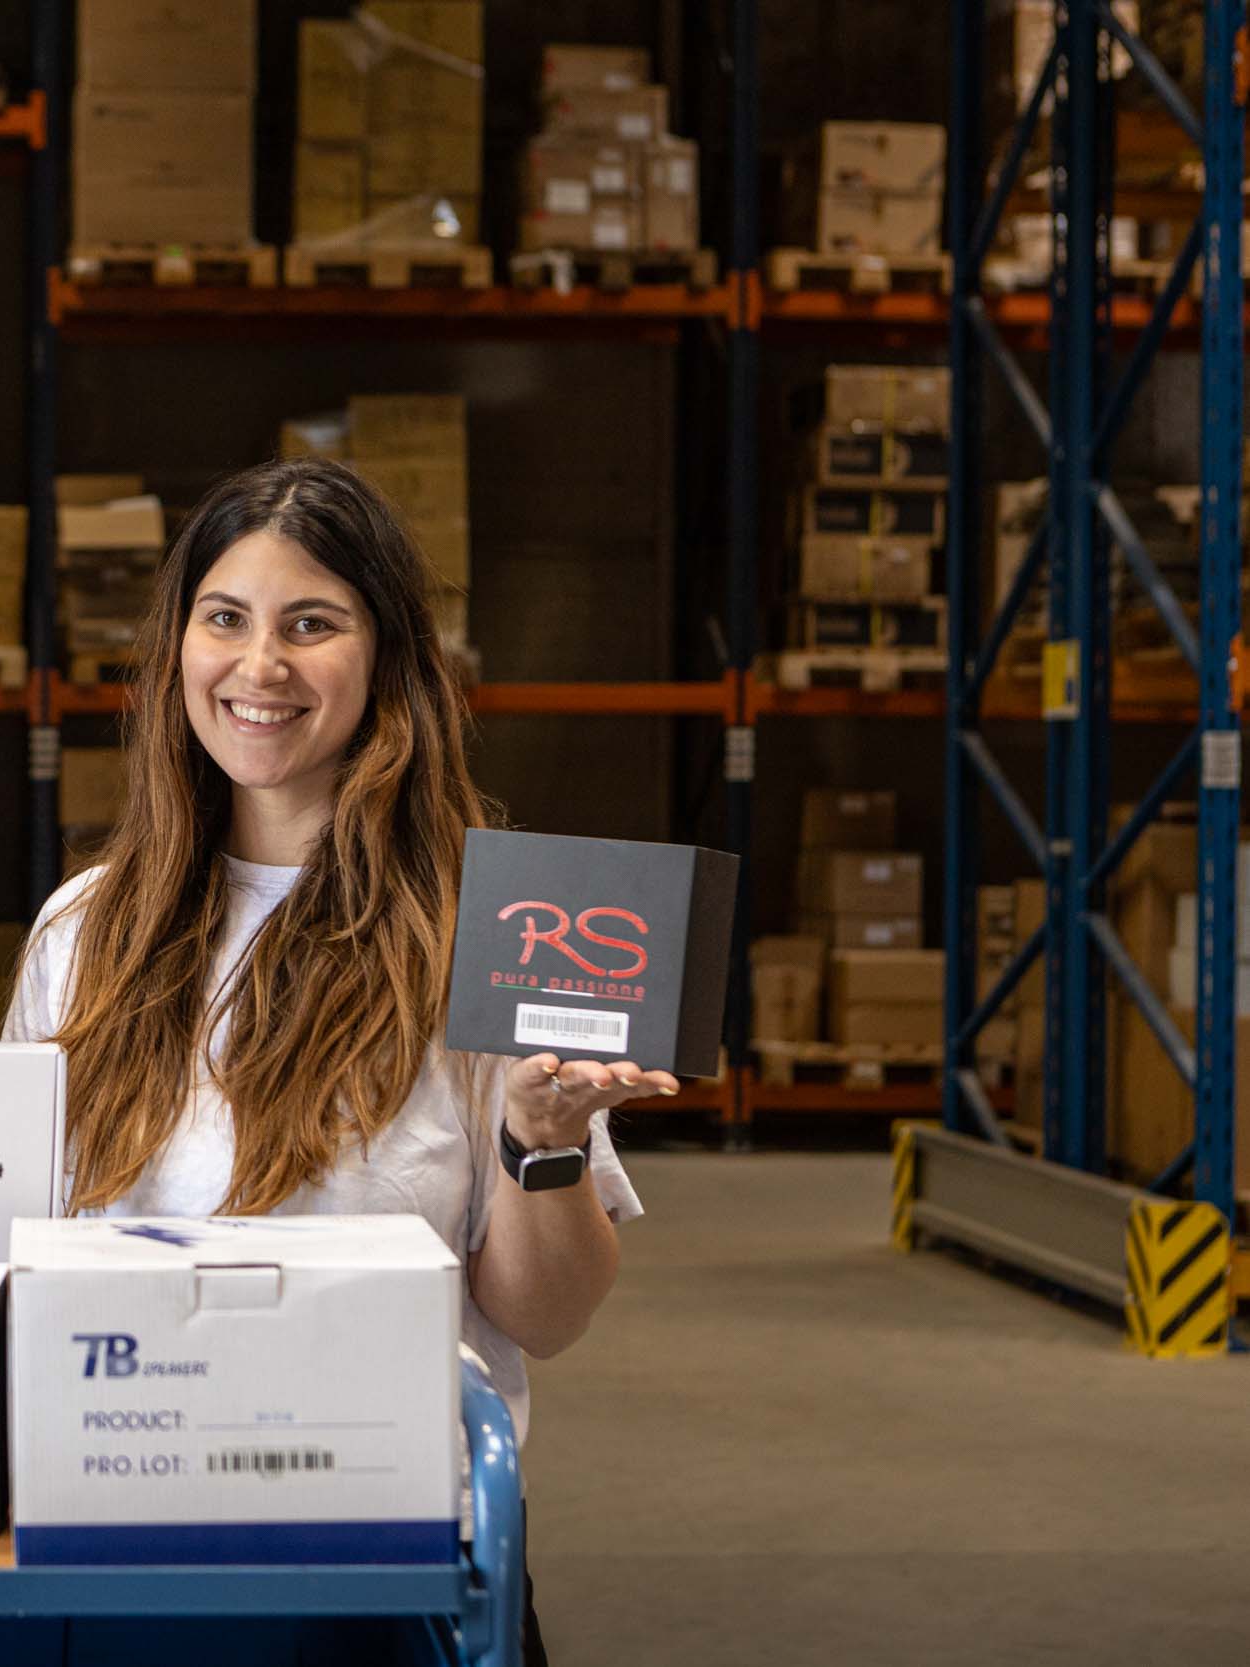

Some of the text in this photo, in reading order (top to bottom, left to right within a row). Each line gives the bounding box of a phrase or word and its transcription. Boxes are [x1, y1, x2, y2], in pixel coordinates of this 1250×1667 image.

[498, 900, 649, 979] RS
[490, 971, 646, 998] pura passione
[72, 1333, 140, 1379] TB
